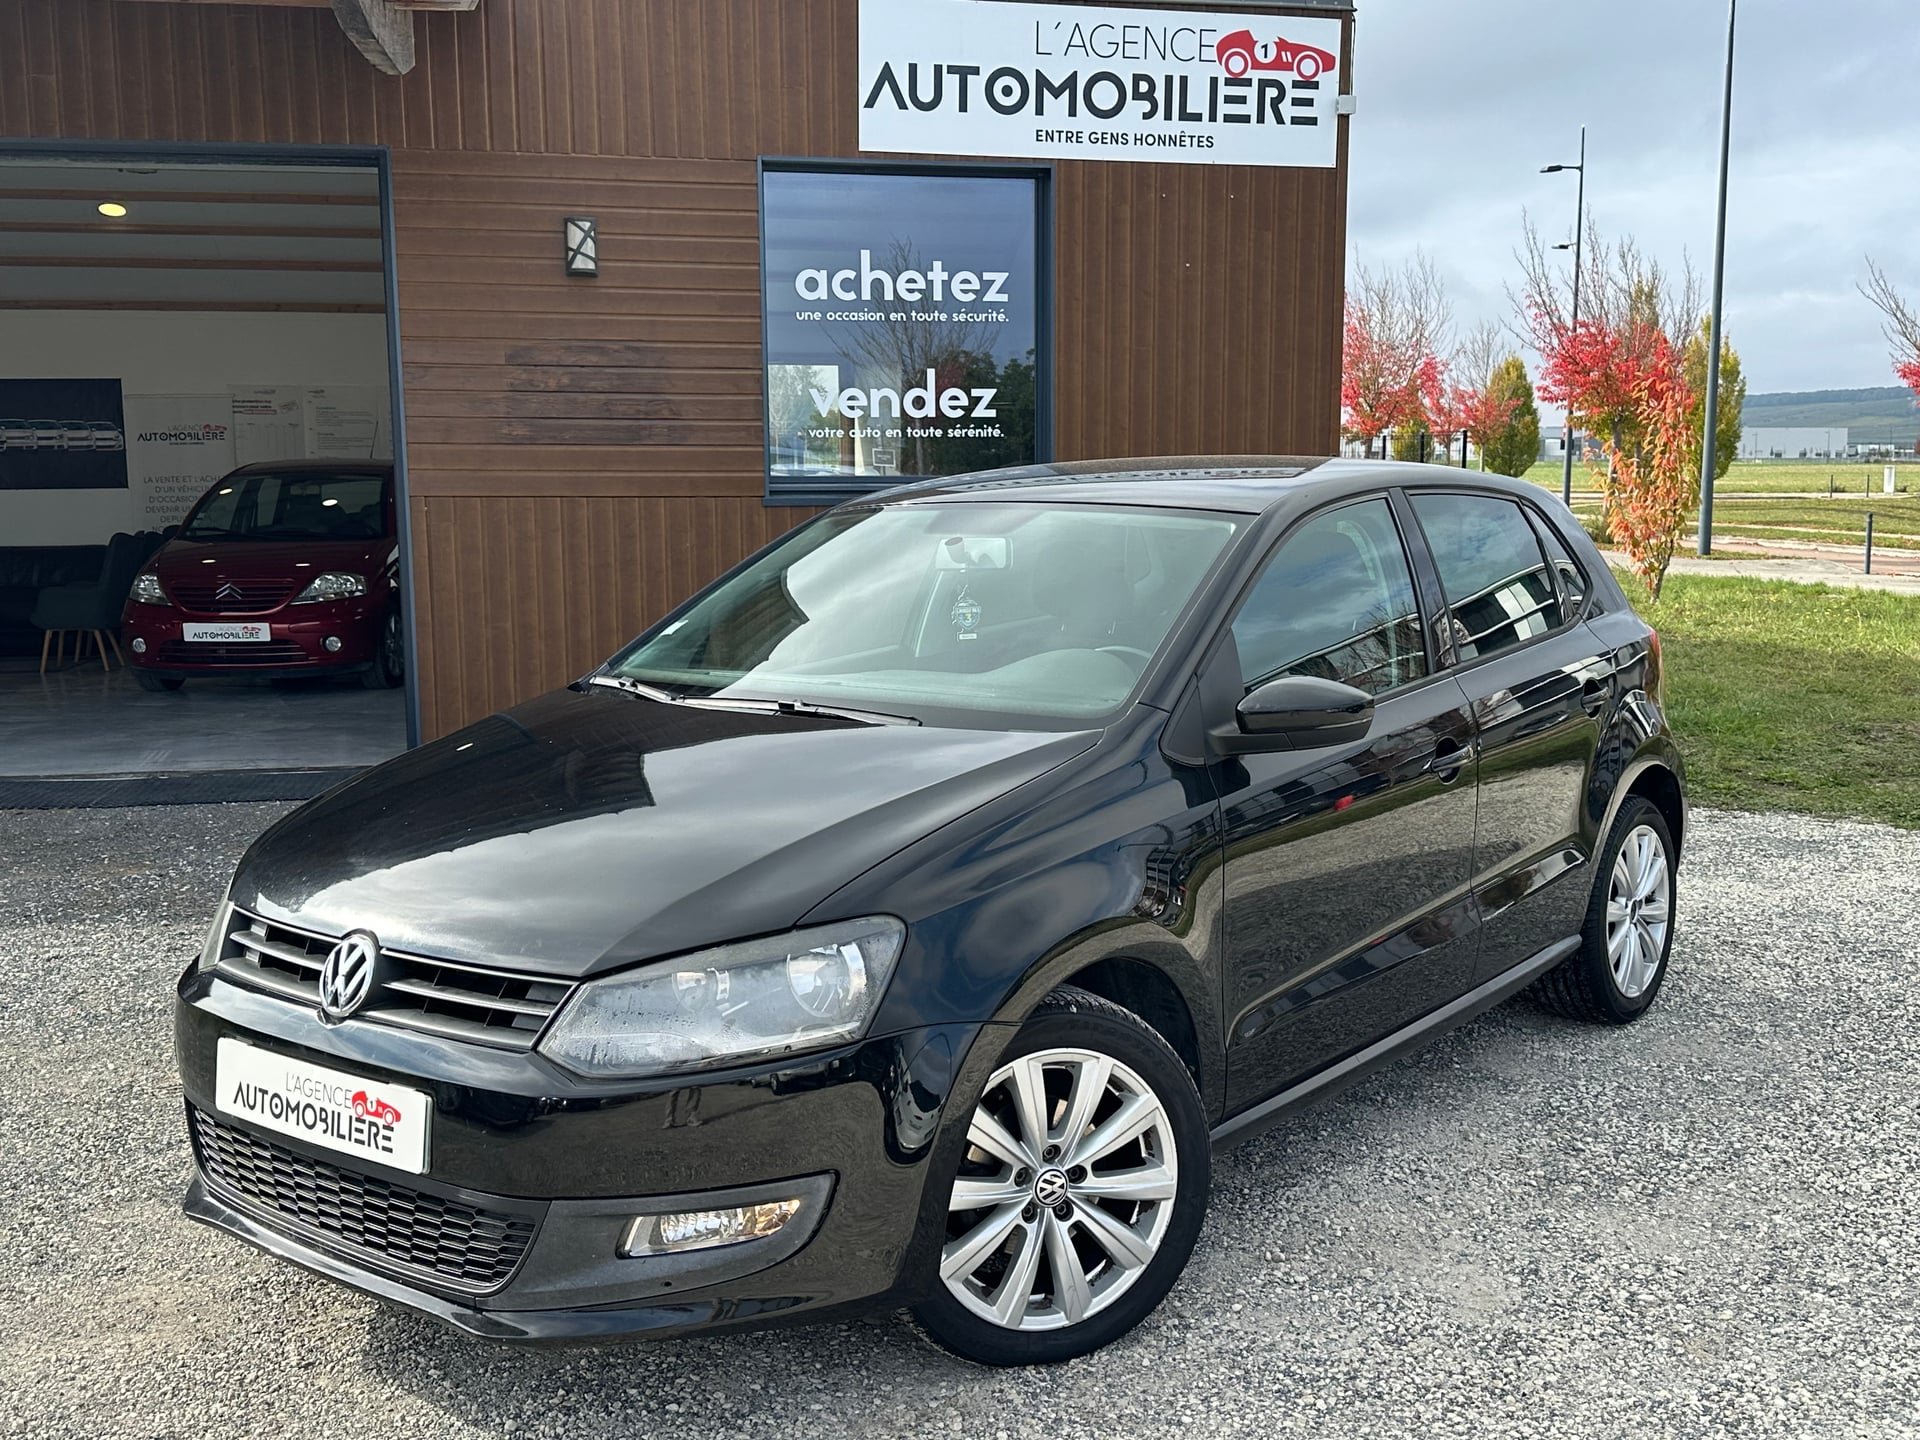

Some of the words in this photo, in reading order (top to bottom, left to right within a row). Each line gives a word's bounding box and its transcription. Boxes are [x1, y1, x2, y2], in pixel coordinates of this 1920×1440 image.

[1035, 20, 1218, 63] L'AGENCE
[1035, 129, 1084, 145] ENTRE
[1088, 130, 1129, 146] GENS
[1133, 130, 1215, 149] HONNÊTES
[795, 249, 1010, 302] achetez
[796, 310, 822, 321] une
[827, 307, 885, 321] occasion
[890, 311, 906, 321] en
[911, 309, 948, 322] toute
[952, 308, 1009, 322] sécurité.
[809, 368, 998, 418] vendez
[808, 427, 844, 438] votre
[850, 427, 881, 438] auto
[885, 428, 902, 438] en
[906, 426, 943, 438] toute
[947, 424, 1004, 438] sérénité.
[155, 476, 181, 484] VENTE
[183, 475, 192, 483] ET
[155, 485, 175, 494] D'UN
[146, 505, 180, 514] DEVENIR
[285, 1071, 353, 1110] L'AGENCE
